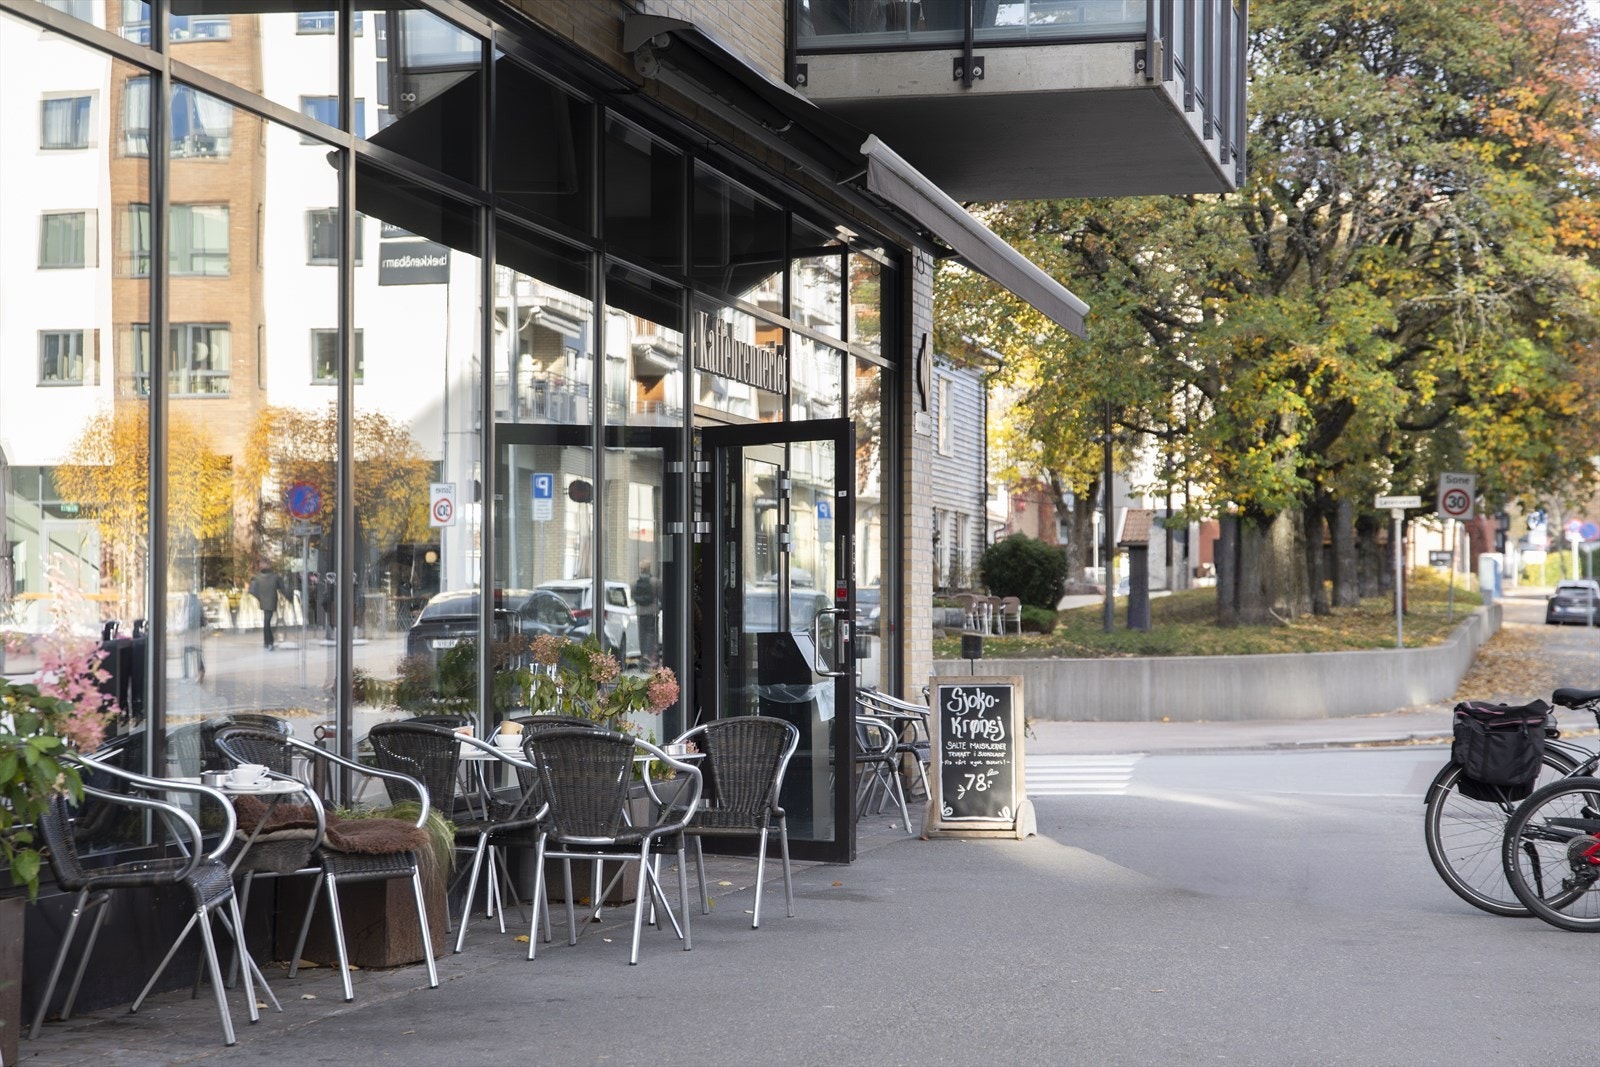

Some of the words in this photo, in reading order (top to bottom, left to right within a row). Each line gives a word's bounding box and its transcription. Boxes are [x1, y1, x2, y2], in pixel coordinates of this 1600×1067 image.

[699, 310, 788, 395] Kaffebrenneriet
[1445, 475, 1470, 485] Sone
[1448, 495, 1465, 509] 30
[946, 687, 1000, 718] Sjoko-
[951, 716, 1006, 741] Krønsj
[946, 741, 967, 750] SALTE
